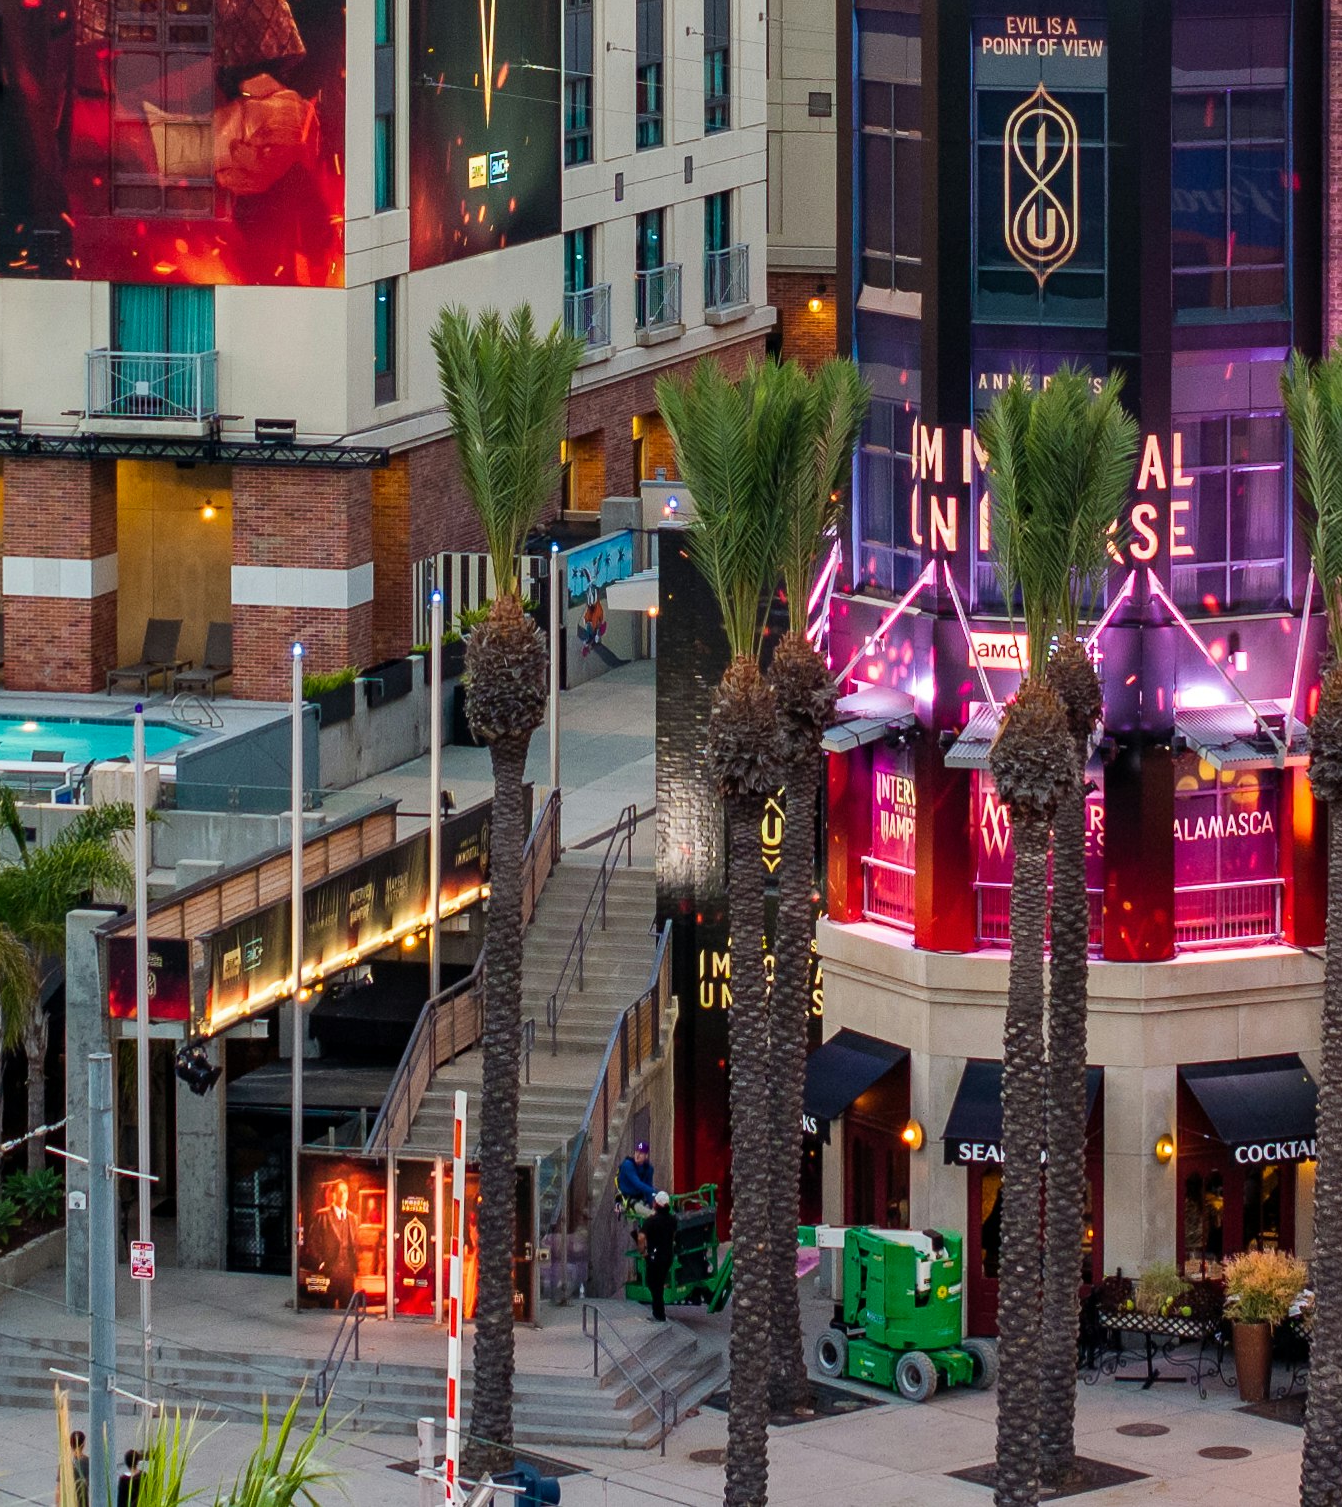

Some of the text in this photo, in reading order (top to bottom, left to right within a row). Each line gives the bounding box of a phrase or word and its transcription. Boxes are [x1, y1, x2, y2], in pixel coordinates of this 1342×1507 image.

[1006, 16, 1078, 36] EVIL IS A
[982, 37, 1104, 58] POINT OF VIEW
[875, 771, 916, 807] INTERV
[880, 810, 916, 845] VAMP
[1173, 810, 1275, 842] ALAMASCA
[1235, 1139, 1315, 1164] COCKTAI
